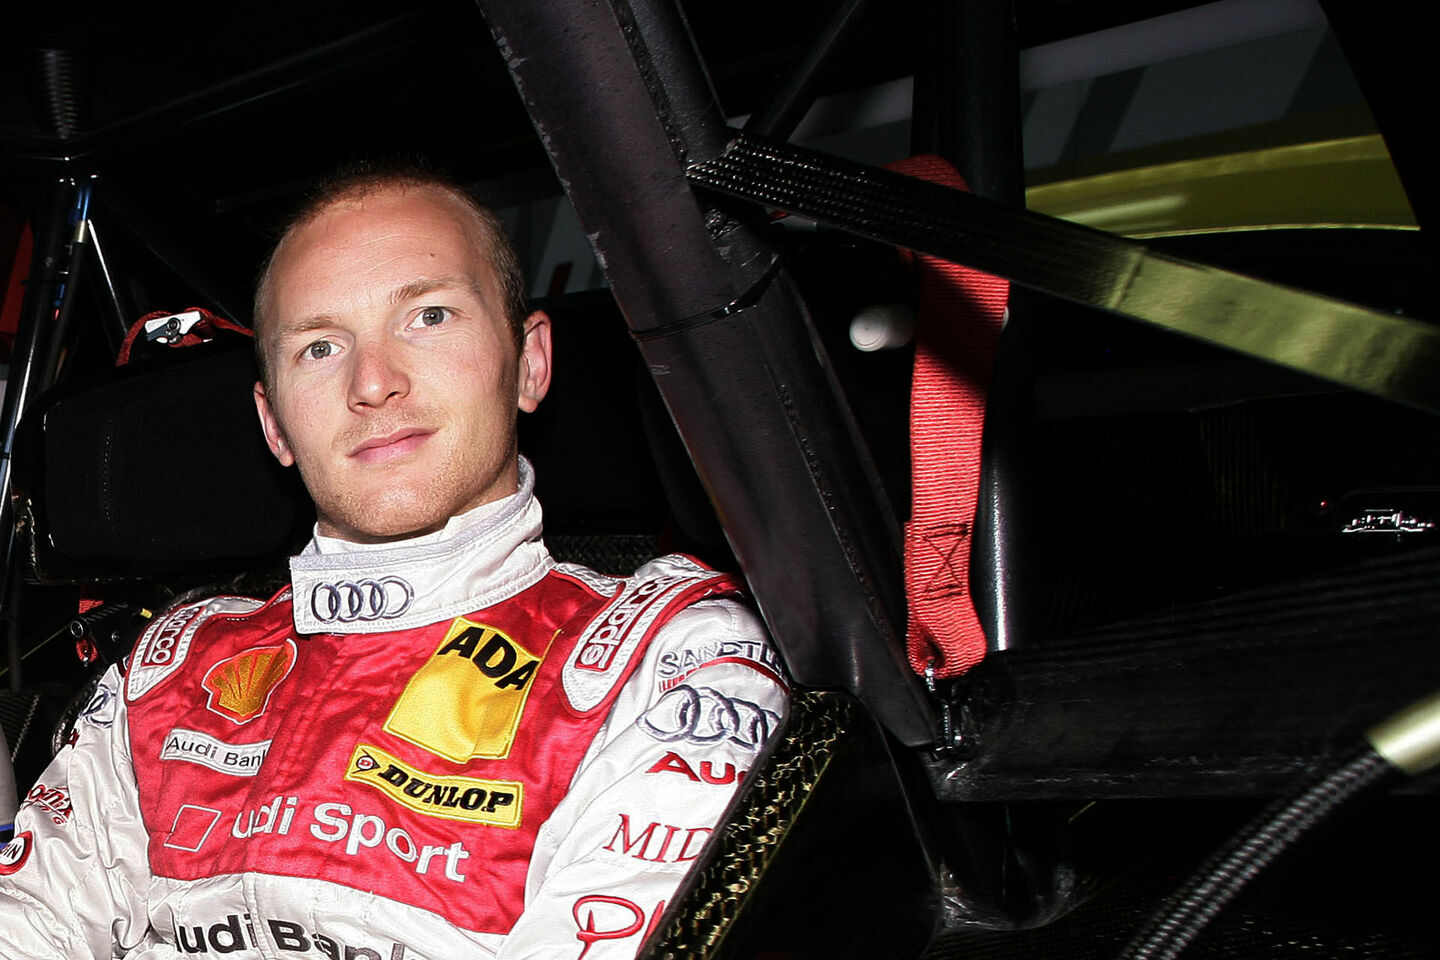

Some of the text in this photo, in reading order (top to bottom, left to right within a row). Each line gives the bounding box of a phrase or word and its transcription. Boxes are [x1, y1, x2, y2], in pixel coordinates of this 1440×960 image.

[437, 626, 540, 691] ADA
[165, 736, 218, 759] Audi
[378, 764, 514, 813] DUNLOP
[231, 796, 469, 883] udi Sport
[171, 914, 259, 954] udi
